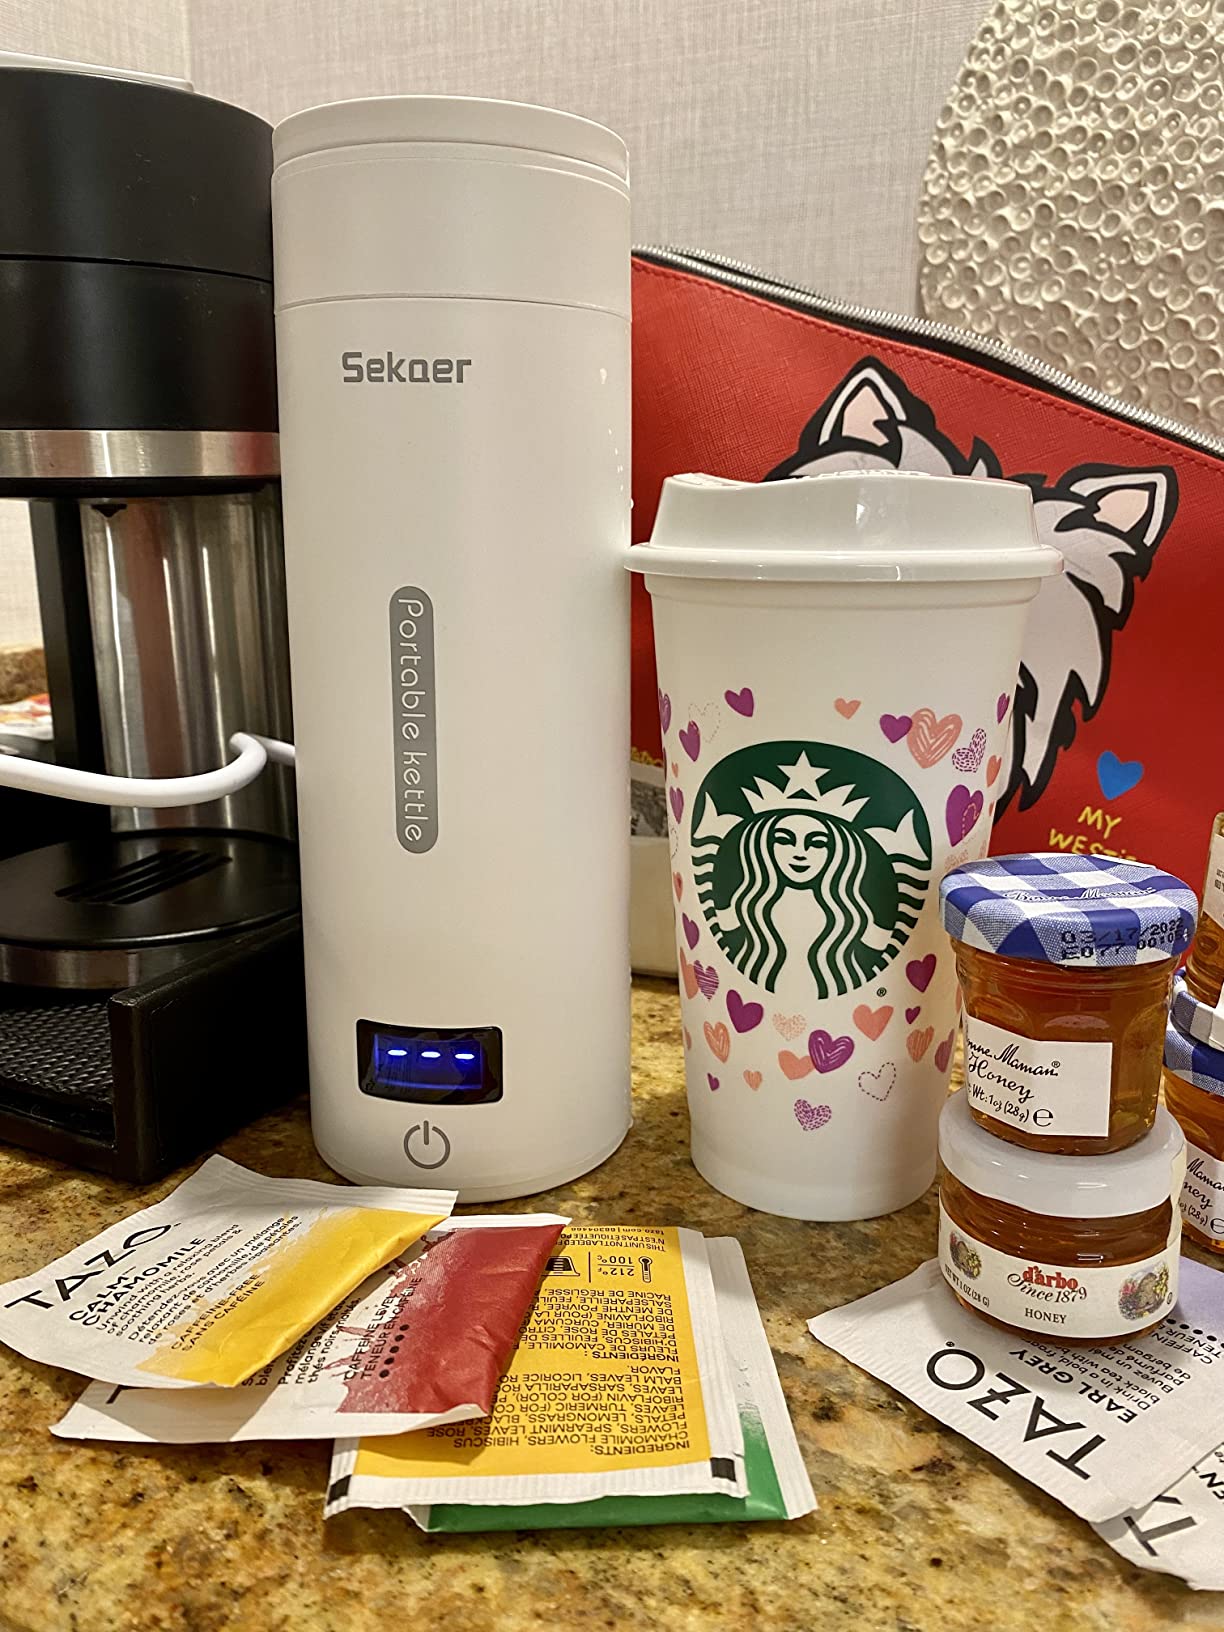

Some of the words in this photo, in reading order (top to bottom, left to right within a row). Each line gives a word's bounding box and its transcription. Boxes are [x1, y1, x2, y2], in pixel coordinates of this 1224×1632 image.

[341, 351, 472, 384] Sekaer
[398, 597, 426, 740] Portable
[1078, 806, 1122, 839] MY
[1061, 917, 1184, 944] 03/17/2022
[967, 1053, 1034, 1104] Honey
[1186, 1158, 1224, 1192] Mama
[1183, 1181, 1213, 1210] ney
[206, 1256, 232, 1276] avec
[243, 1217, 285, 1248] mélange
[563, 1239, 603, 1247] LABELED
[603, 1240, 623, 1248] NOT
[624, 1241, 645, 1249] UNIT
[646, 1243, 666, 1252] THIS
[4, 1222, 173, 1312] TAZO
[82, 1238, 206, 1326] CHAMOMILE
[95, 1293, 139, 1331] Unwind
[136, 1276, 163, 1298] with
[172, 1242, 213, 1272] relaxing
[210, 1223, 239, 1243] blend
[106, 1321, 119, 1335] of
[179, 1257, 203, 1274] rose
[202, 1235, 232, 1258] petals
[1007, 1272, 1053, 1303] Since
[1054, 1285, 1088, 1304] 1879
[544, 1288, 605, 1298] RÉGLISSE,
[608, 1290, 624, 1298] DE
[627, 1290, 671, 1301] RACINE
[112, 1293, 162, 1337] soothing
[159, 1265, 195, 1294] herbs.
[575, 1295, 672, 1308] SALSEPAREILLE,
[170, 1273, 261, 1350] CAFFEINE-FREE
[543, 1303, 598, 1312] POIVRÉE,
[601, 1305, 653, 1314] MENTHE
[657, 1307, 673, 1316] DE
[162, 1304, 192, 1331] roses
[178, 1320, 215, 1352] SANS
[213, 1280, 265, 1320] CAFÉINE
[533, 1311, 550, 1319] LA
[553, 1310, 593, 1319] (POUR
[595, 1312, 674, 1323] RIBOFLAVINE
[1024, 1308, 1068, 1324] HONEY
[136, 1301, 183, 1343] relaxant
[532, 1319, 599, 1327] CURCUMA
[659, 1324, 675, 1332] DE
[560, 1325, 597, 1334] ROSE,
[601, 1328, 618, 1337] DE
[621, 1330, 675, 1340] PÉTALES
[541, 1333, 598, 1343] FEUILLES
[602, 1336, 677, 1347] D'HIBISCUS,
[1166, 1327, 1222, 1359] TENEUR
[342, 1319, 379, 1381] CAFFEINE
[524, 1341, 606, 1351] CAMOMILLE,
[609, 1344, 626, 1352] DE
[630, 1344, 678, 1355] FLEURS
[1151, 1329, 1213, 1365] CAFFEIN
[295, 1333, 324, 1384] mélange
[307, 1356, 327, 1383] thés
[321, 1328, 340, 1354] noirs
[359, 1331, 391, 1381] TENEUR
[1070, 1352, 1099, 1370] with
[1122, 1340, 1172, 1371] bergam
[627, 1365, 680, 1375] FLAVOR.
[1008, 1347, 1074, 1386] GREY
[1057, 1354, 1089, 1375] bold,
[1125, 1354, 1184, 1387] parfumé
[522, 1373, 582, 1382] LICORICE
[587, 1372, 639, 1383] LEAVES,
[643, 1375, 681, 1385] BALM
[1099, 1366, 1123, 1382] tea
[525, 1382, 625, 1392] SARSAPARILLA
[1132, 1368, 1174, 1394] Buvez
[627, 1383, 682, 1395] LEAVES,
[1123, 1379, 1161, 1405] black
[512, 1392, 567, 1402] COLOR),
[571, 1392, 602, 1403] (FOR
[607, 1393, 683, 1404] RIBOFLAVIN
[1114, 1385, 1152, 1411] Drink
[520, 1402, 551, 1413] (FOR
[555, 1402, 627, 1412] TURMERIC
[627, 1403, 684, 1414] LEAVES,
[1077, 1386, 1139, 1425] EARL
[525, 1412, 627, 1423] LEMONGRASS,
[631, 1411, 686, 1423] PETALS,
[428, 1427, 466, 1437] ROSE
[472, 1424, 526, 1436] LEAVES,
[531, 1423, 612, 1434] SPEARMINT
[616, 1420, 687, 1433] FLOWERS,
[453, 1436, 520, 1448] HIBISCUS
[524, 1434, 596, 1446] FLOWERS,
[600, 1430, 688, 1444] CHAMOMILE
[590, 1440, 690, 1456] INGREDIENTS:
